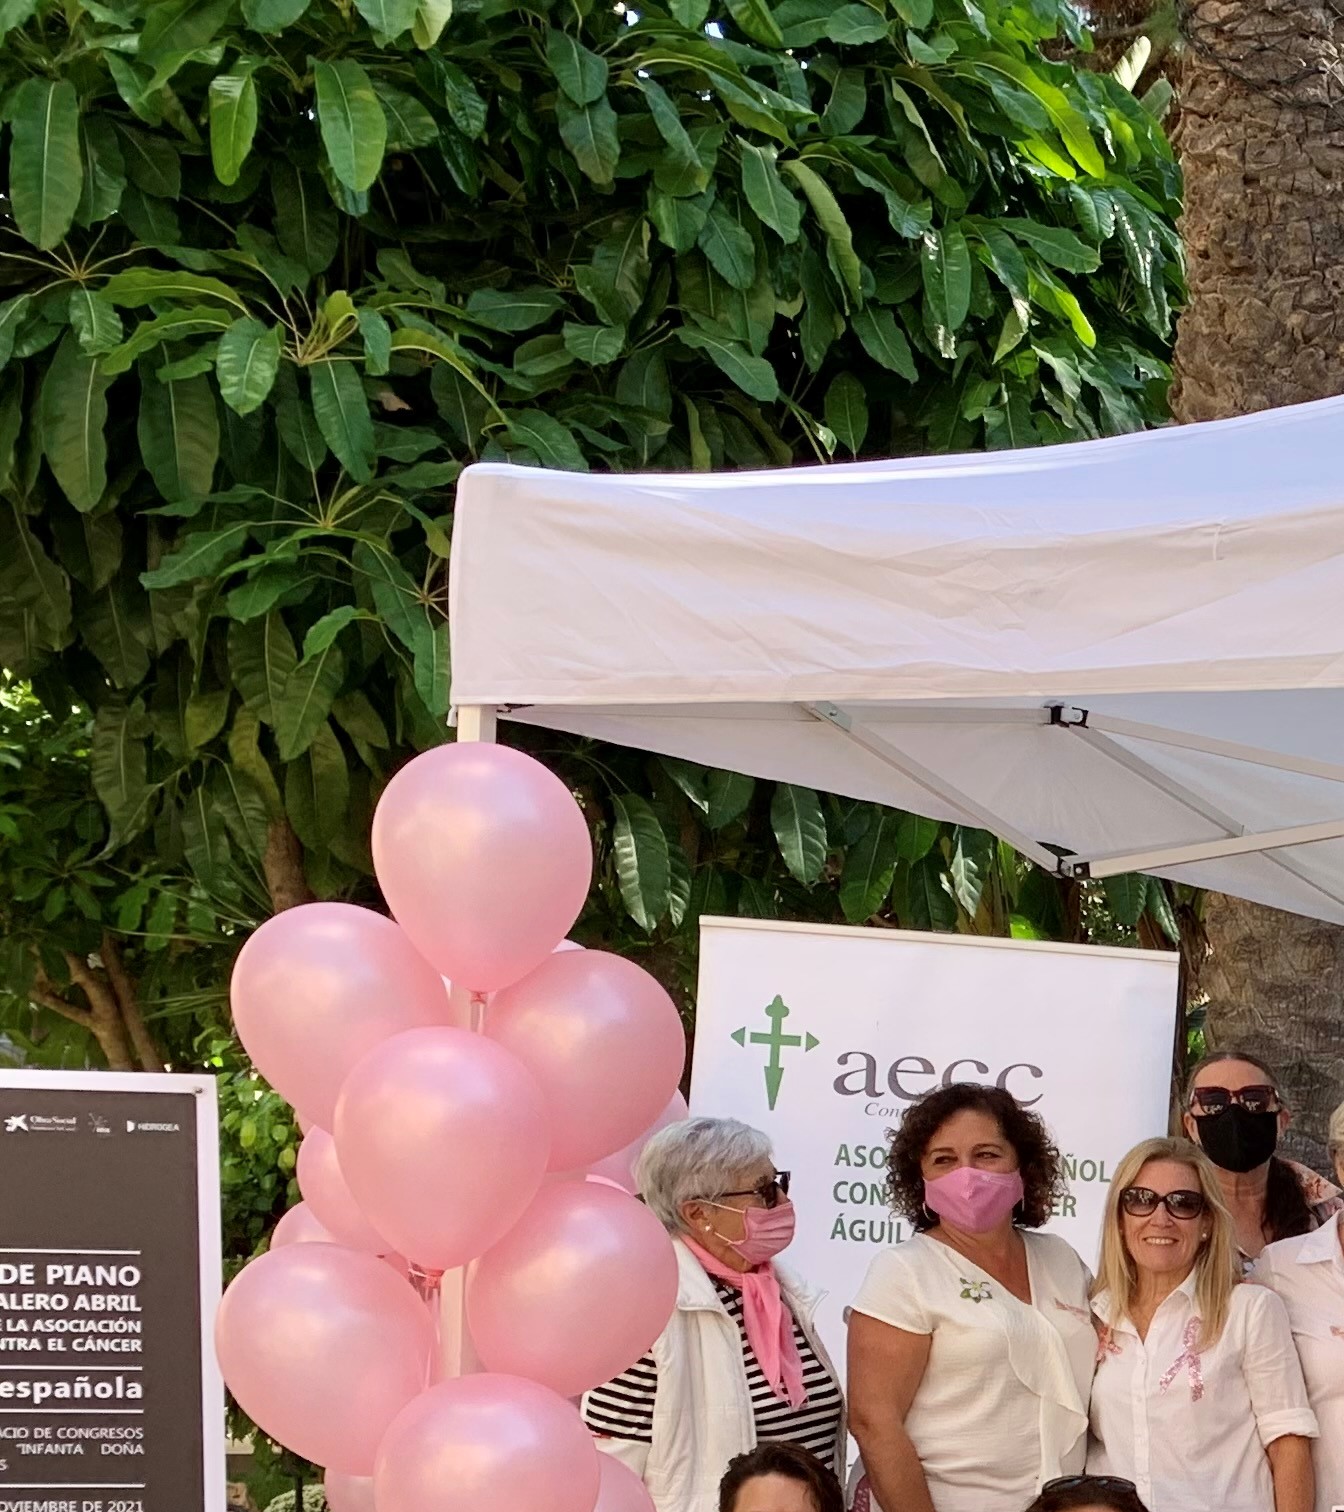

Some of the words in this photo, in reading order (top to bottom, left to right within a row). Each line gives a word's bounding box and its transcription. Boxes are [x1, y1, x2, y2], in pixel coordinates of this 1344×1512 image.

[0, 1264, 35, 1285] DE
[46, 1264, 141, 1287] PIANO
[73, 1294, 142, 1312] ABRIL
[6, 1318, 29, 1332] LA
[32, 1316, 141, 1334] ASOCIACIÓN
[47, 1338, 67, 1352] EL
[71, 1335, 142, 1353] CÁNCER
[0, 1376, 143, 1404] española
[33, 1427, 53, 1439] DE
[56, 1427, 144, 1440] CONGRESOS
[100, 1442, 144, 1456] DOÑA
